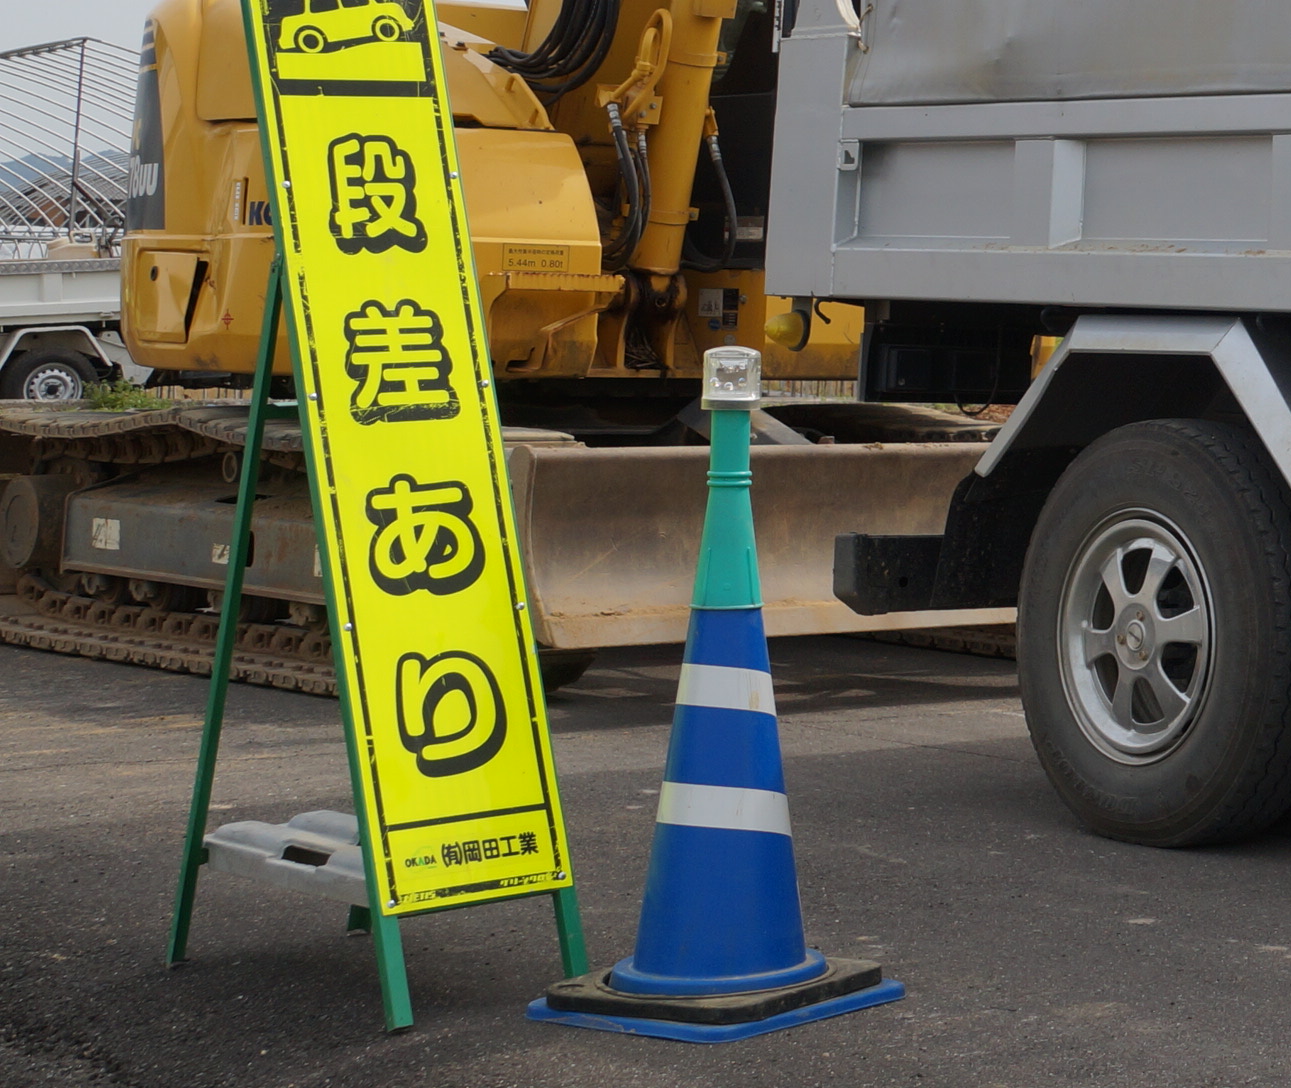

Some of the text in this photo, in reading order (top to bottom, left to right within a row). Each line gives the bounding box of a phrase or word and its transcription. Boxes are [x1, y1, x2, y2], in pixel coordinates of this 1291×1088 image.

[508, 258, 564, 269] 5.44m 0.80t
[328, 132, 508, 778] 段差あり
[404, 854, 437, 868] OKADA
